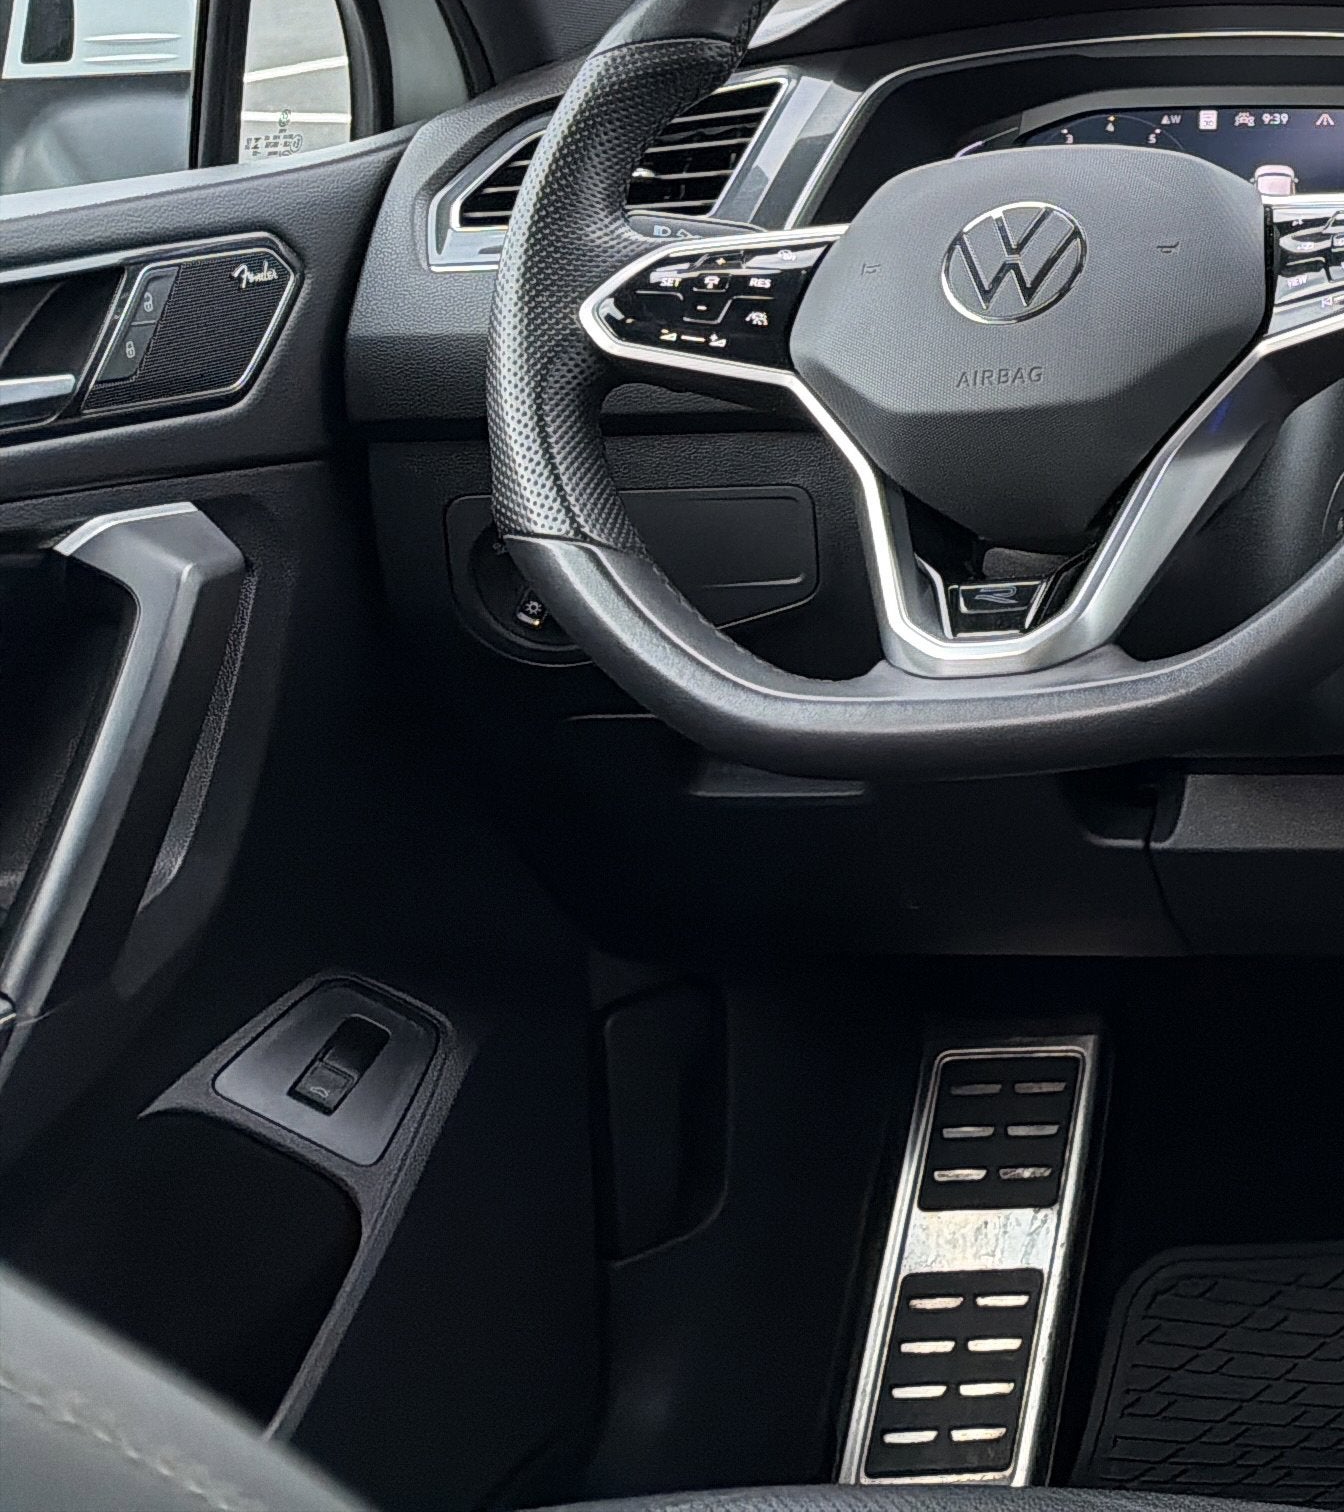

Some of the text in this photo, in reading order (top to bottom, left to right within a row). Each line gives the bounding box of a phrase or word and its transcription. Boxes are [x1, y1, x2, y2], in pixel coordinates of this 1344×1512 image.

[1262, 113, 1289, 125] 9:39
[660, 277, 682, 287] SET
[749, 277, 771, 288] RES
[1287, 274, 1308, 287] VIEW
[955, 366, 1043, 388] AIRBAG
